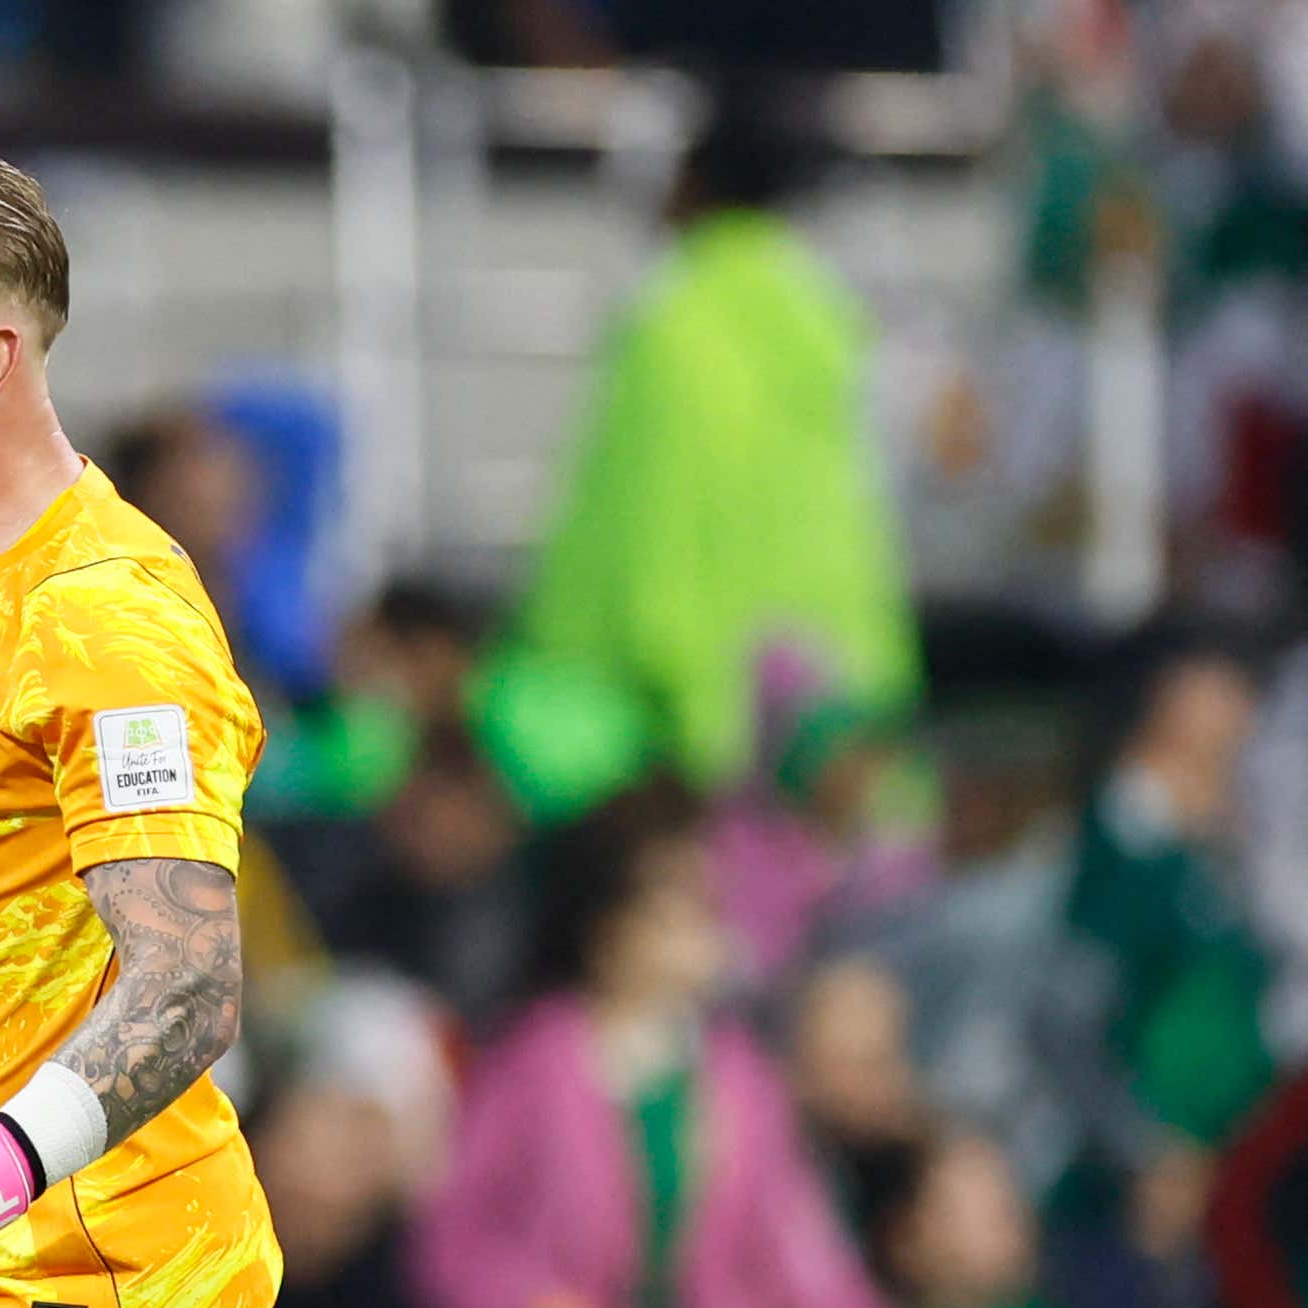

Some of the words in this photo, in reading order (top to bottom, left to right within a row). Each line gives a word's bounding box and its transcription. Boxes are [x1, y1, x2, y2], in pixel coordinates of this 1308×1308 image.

[121, 751, 150, 769] Unite
[116, 768, 177, 788] EDUCATION
[137, 787, 159, 797] FIFA
